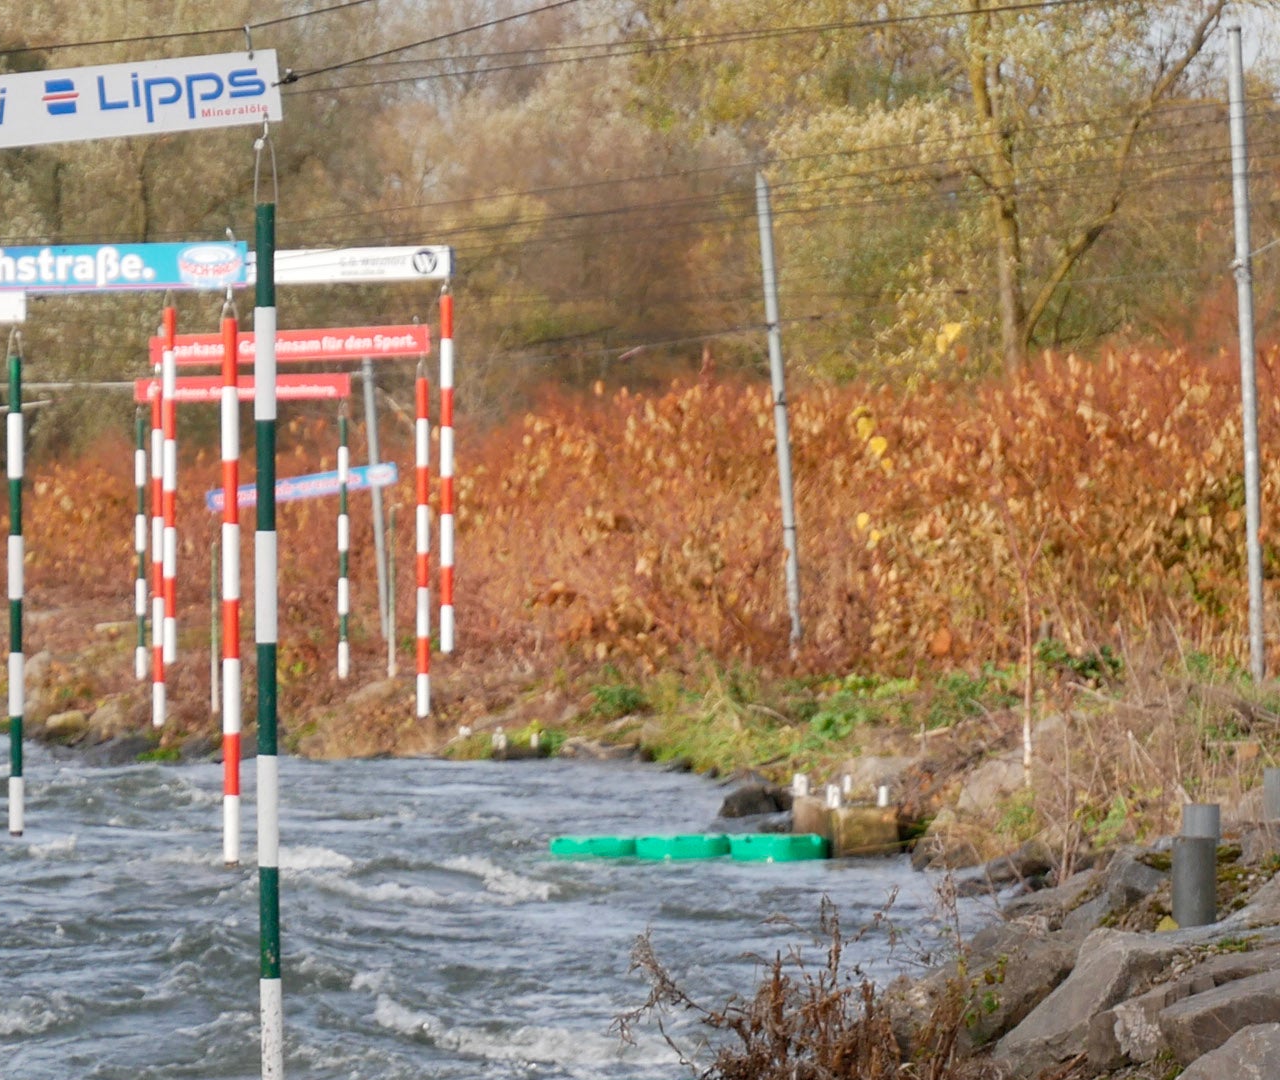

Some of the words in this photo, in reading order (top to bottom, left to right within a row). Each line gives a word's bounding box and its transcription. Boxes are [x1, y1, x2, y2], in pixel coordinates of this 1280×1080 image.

[96, 67, 267, 124] Lipps
[200, 104, 269, 119] Mineralöle
[345, 334, 372, 349] den
